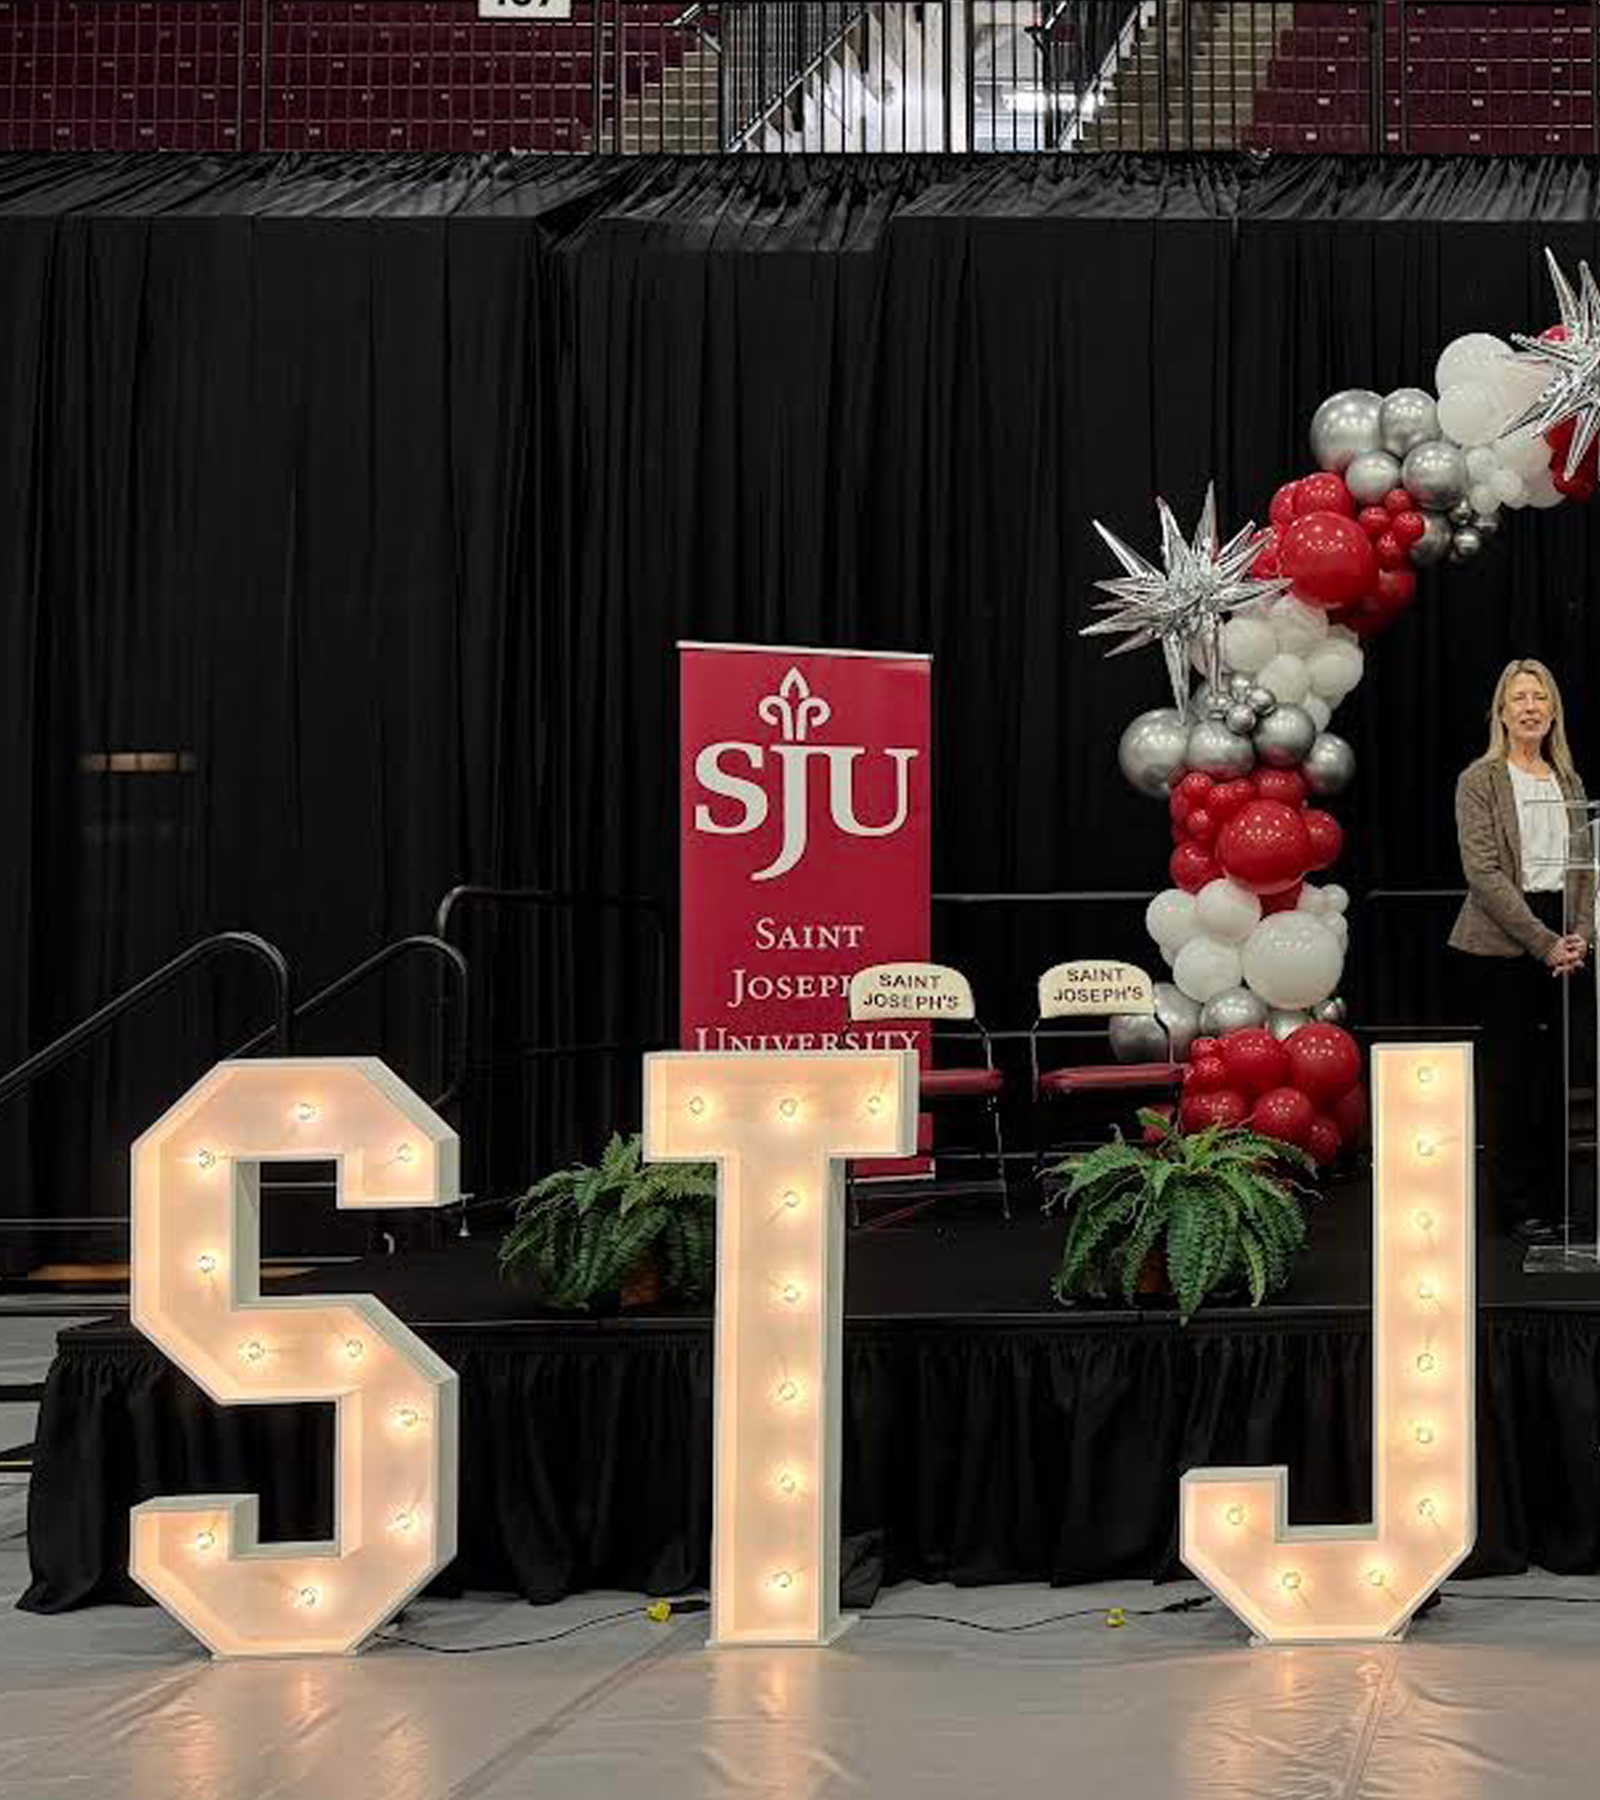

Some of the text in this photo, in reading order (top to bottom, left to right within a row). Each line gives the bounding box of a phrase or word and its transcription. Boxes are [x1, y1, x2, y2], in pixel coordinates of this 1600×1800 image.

[695, 741, 919, 881] SJU
[755, 917, 865, 950] SAINT
[878, 972, 942, 990] SAINT
[1066, 966, 1125, 984] SAINT
[862, 992, 959, 1011] JOSEPH'S
[1053, 984, 1144, 1003] JOSEPH'S
